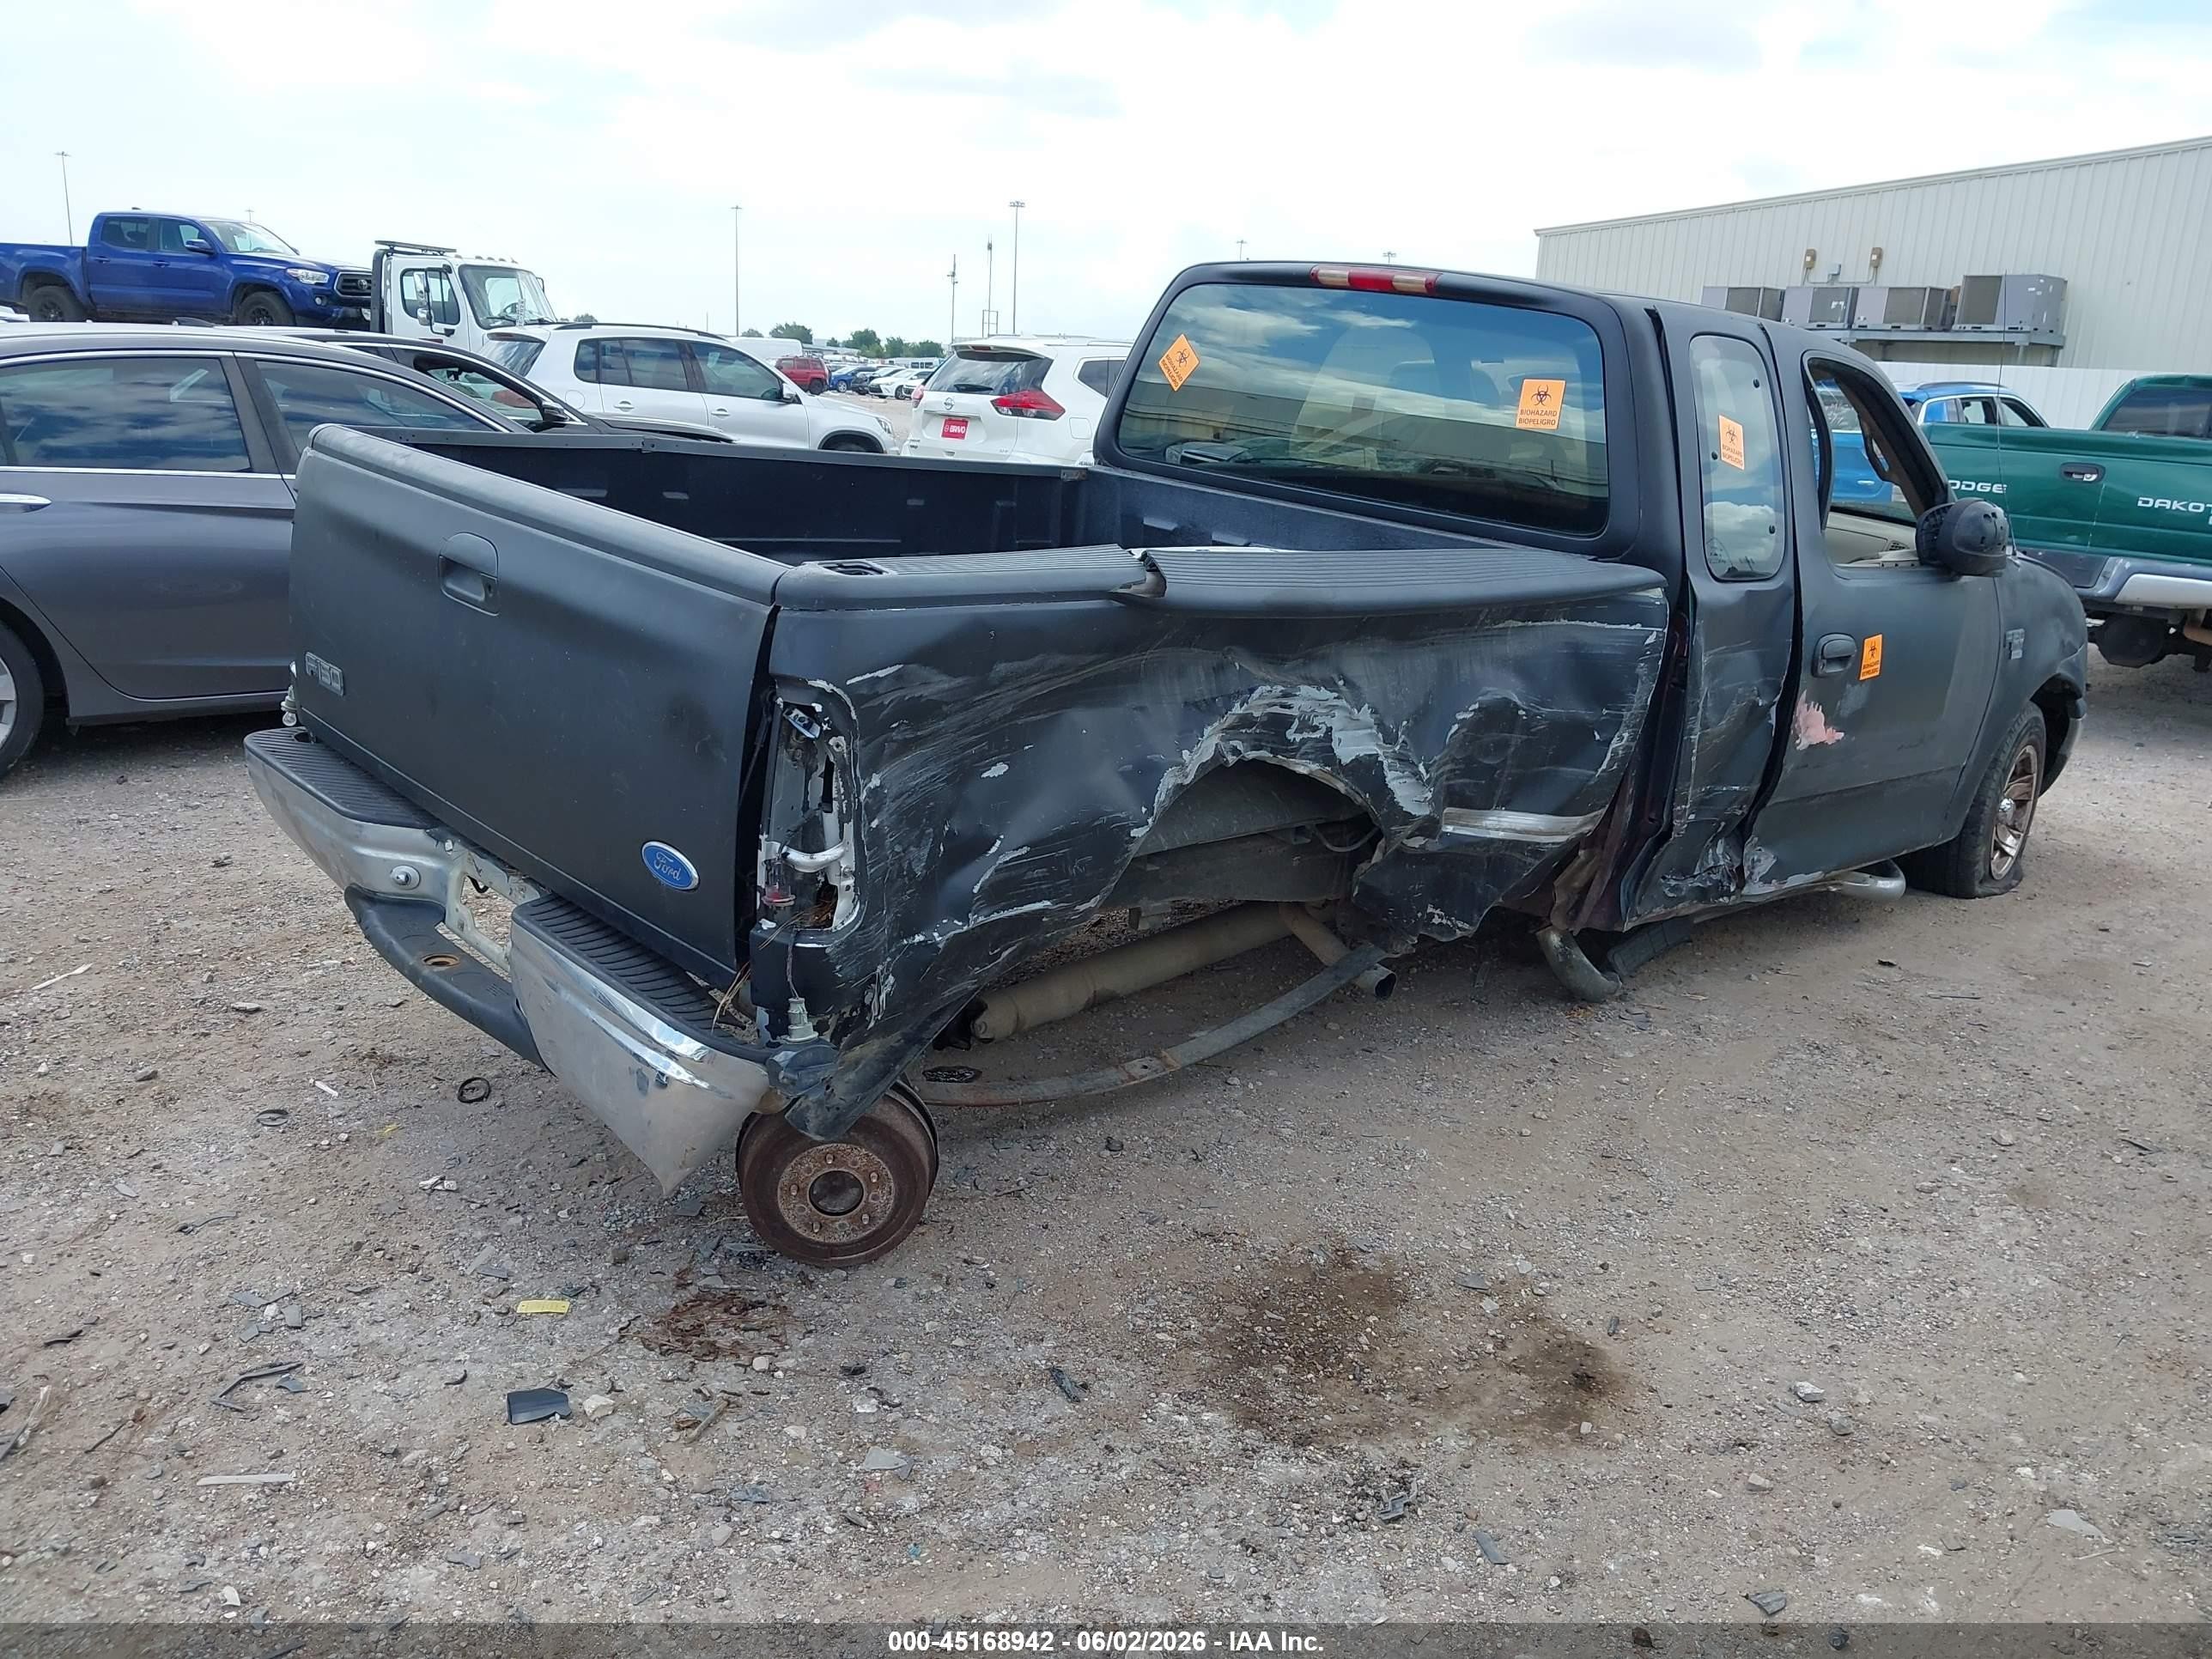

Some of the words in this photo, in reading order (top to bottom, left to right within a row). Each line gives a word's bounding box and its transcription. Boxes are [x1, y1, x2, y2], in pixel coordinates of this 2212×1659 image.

[1520, 409, 1558, 417] BIOHAZARD
[1518, 417, 1556, 426] BIOPELIGRO
[1948, 479, 2008, 494] ODGE
[653, 851, 683, 881] Ford
